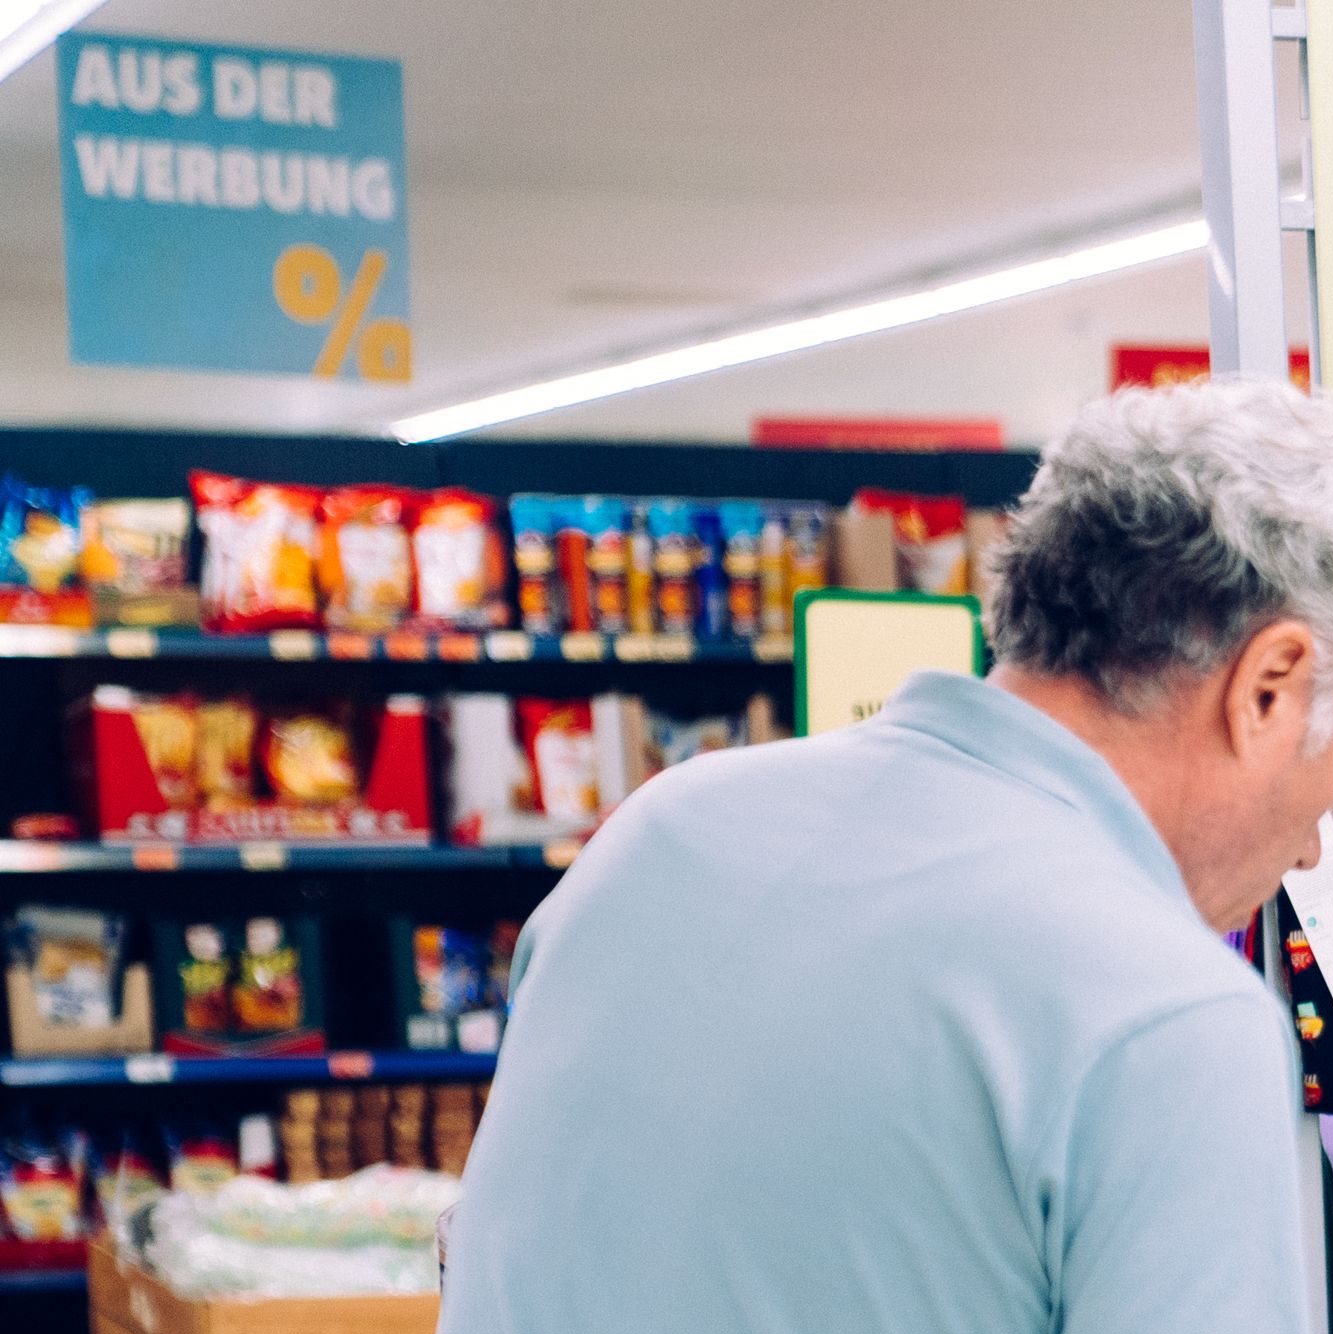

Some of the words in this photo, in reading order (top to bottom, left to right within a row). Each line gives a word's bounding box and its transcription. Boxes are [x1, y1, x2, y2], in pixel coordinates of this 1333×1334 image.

[73, 45, 201, 116] AUS
[213, 57, 337, 128] DER
[75, 137, 396, 221] WERBUNG
